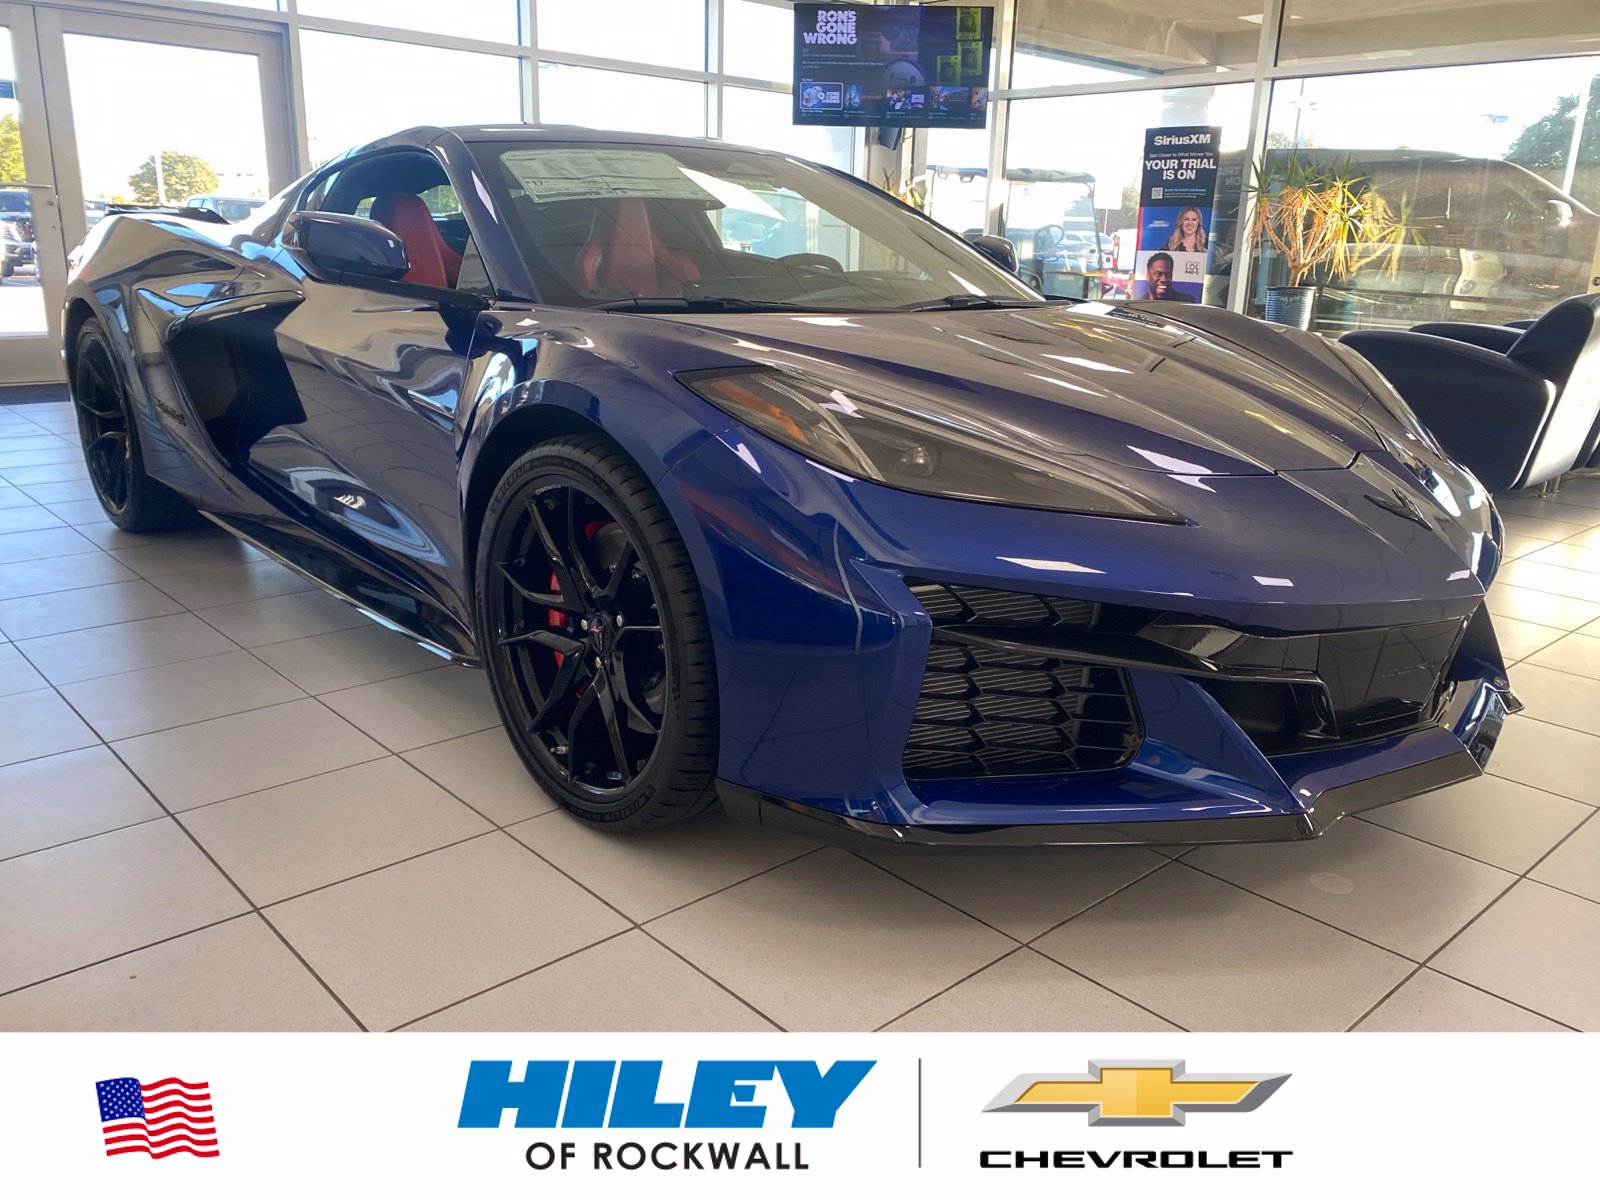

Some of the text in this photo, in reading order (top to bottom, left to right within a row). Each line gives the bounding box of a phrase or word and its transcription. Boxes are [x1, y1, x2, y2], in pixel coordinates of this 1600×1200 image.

[817, 10, 857, 22] RON'S
[816, 22, 856, 34] GONE
[803, 32, 857, 45] WRONG
[1154, 134, 1211, 145] SiriusXM
[1145, 158, 1217, 170] YOUR TRIAL
[1163, 169, 1196, 180] IS ON
[1185, 263, 1199, 271] LOL
